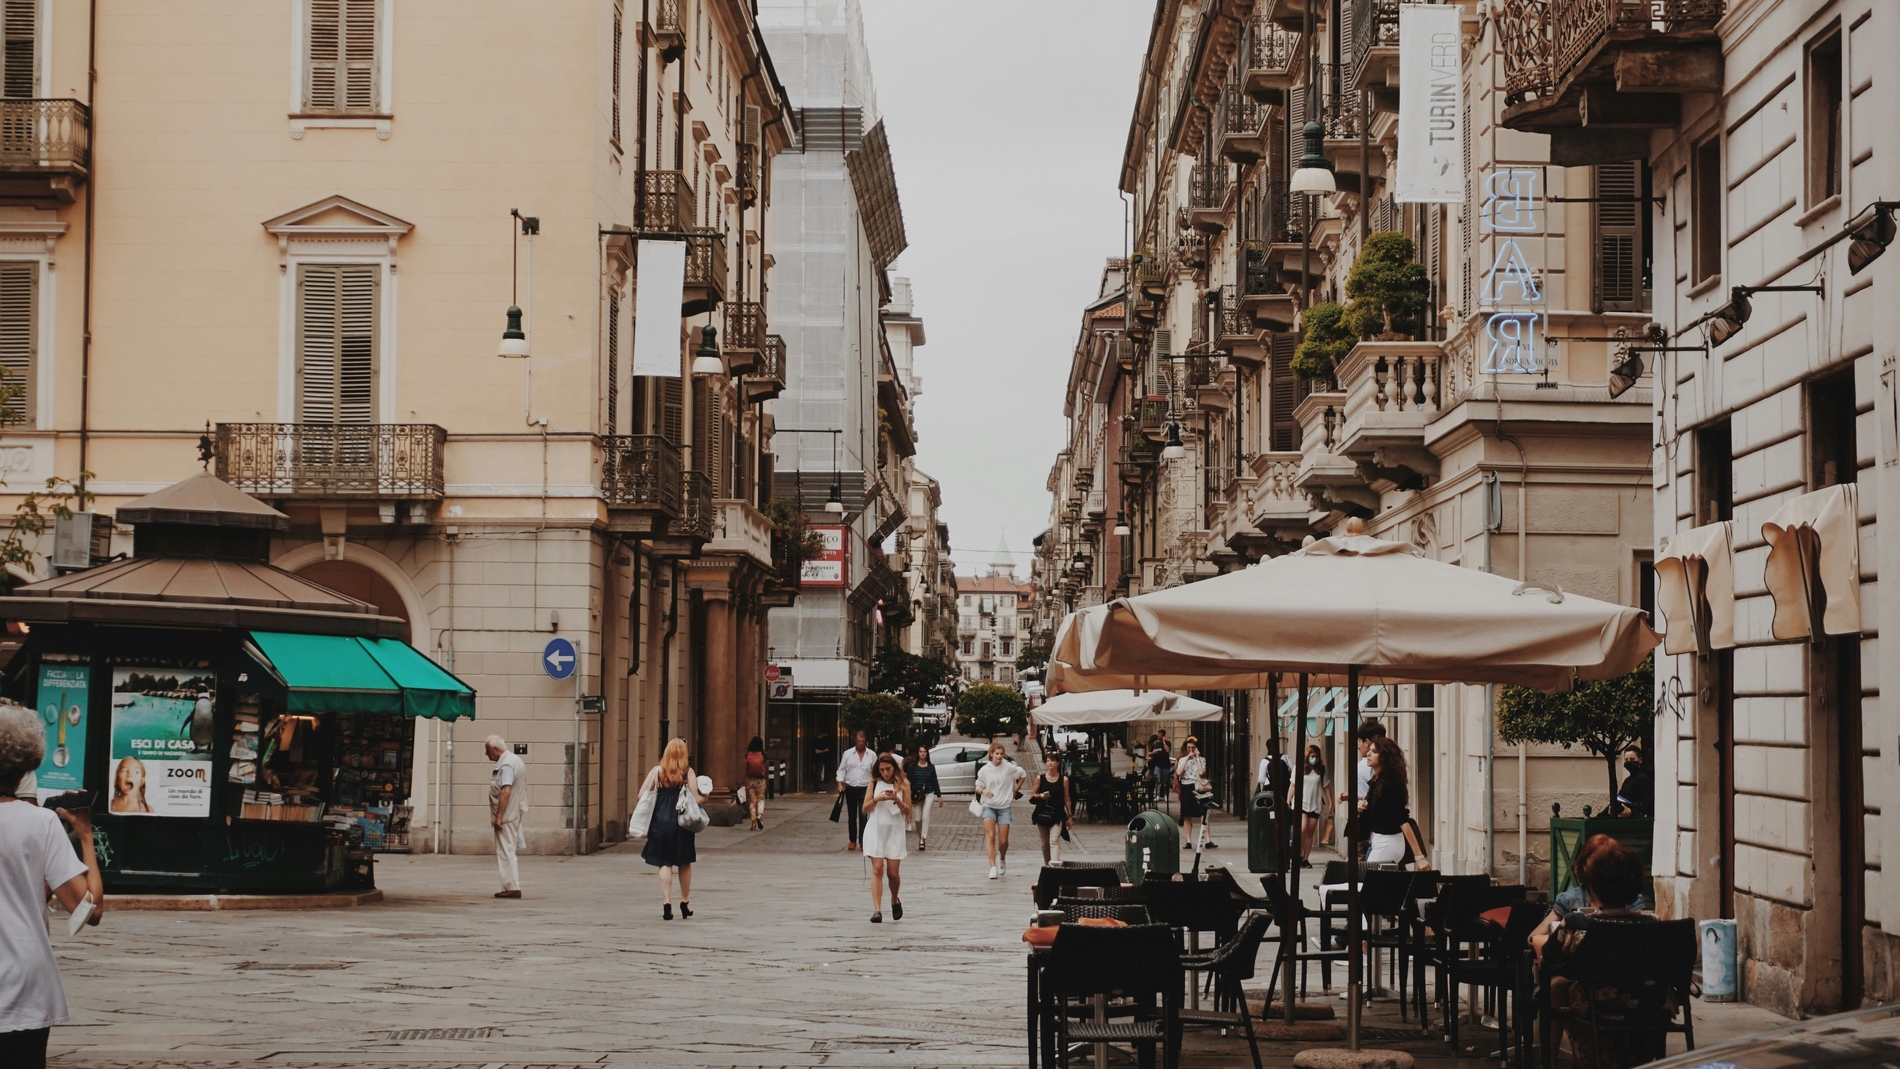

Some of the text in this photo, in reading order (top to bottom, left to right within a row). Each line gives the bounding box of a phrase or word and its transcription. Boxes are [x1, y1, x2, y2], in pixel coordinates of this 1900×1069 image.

[1522, 343, 1535, 351] VI
[1499, 357, 1531, 366] NDEA
[76, 671, 84, 680] LA
[131, 739, 196, 750] ESCI DI CASA
